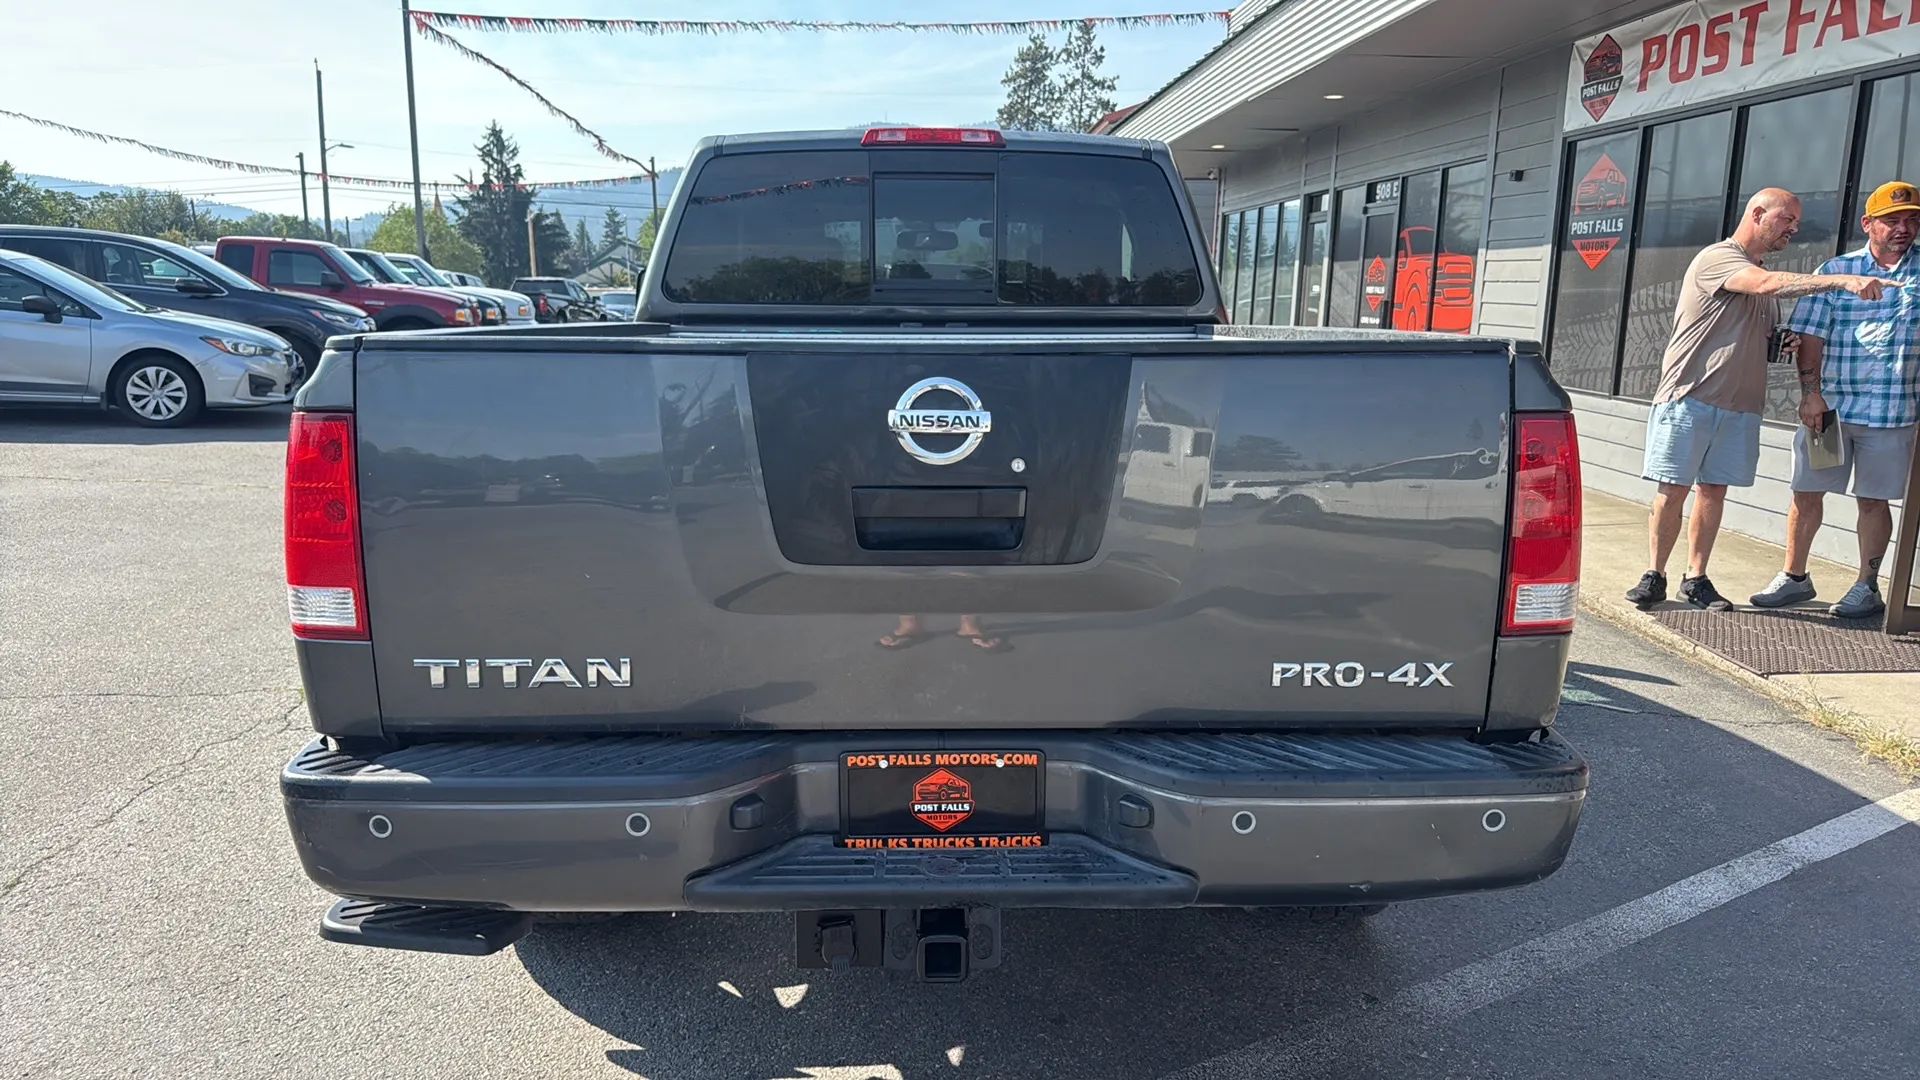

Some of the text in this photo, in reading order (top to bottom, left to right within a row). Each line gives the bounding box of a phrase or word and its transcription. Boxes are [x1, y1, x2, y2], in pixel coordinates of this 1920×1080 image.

[1636, 0, 1920, 93] POST FAL
[1582, 79, 1620, 98] POST FALLS
[1570, 217, 1624, 235] POST FALLS
[1580, 240, 1610, 251] MOTORS
[899, 414, 980, 428] NISSAN
[413, 658, 632, 688] TITAN
[1271, 661, 1454, 687] PRO-4X
[888, 754, 933, 766] FALLS
[914, 803, 970, 812] POST FALLS
[911, 837, 976, 849] TRUCKS
